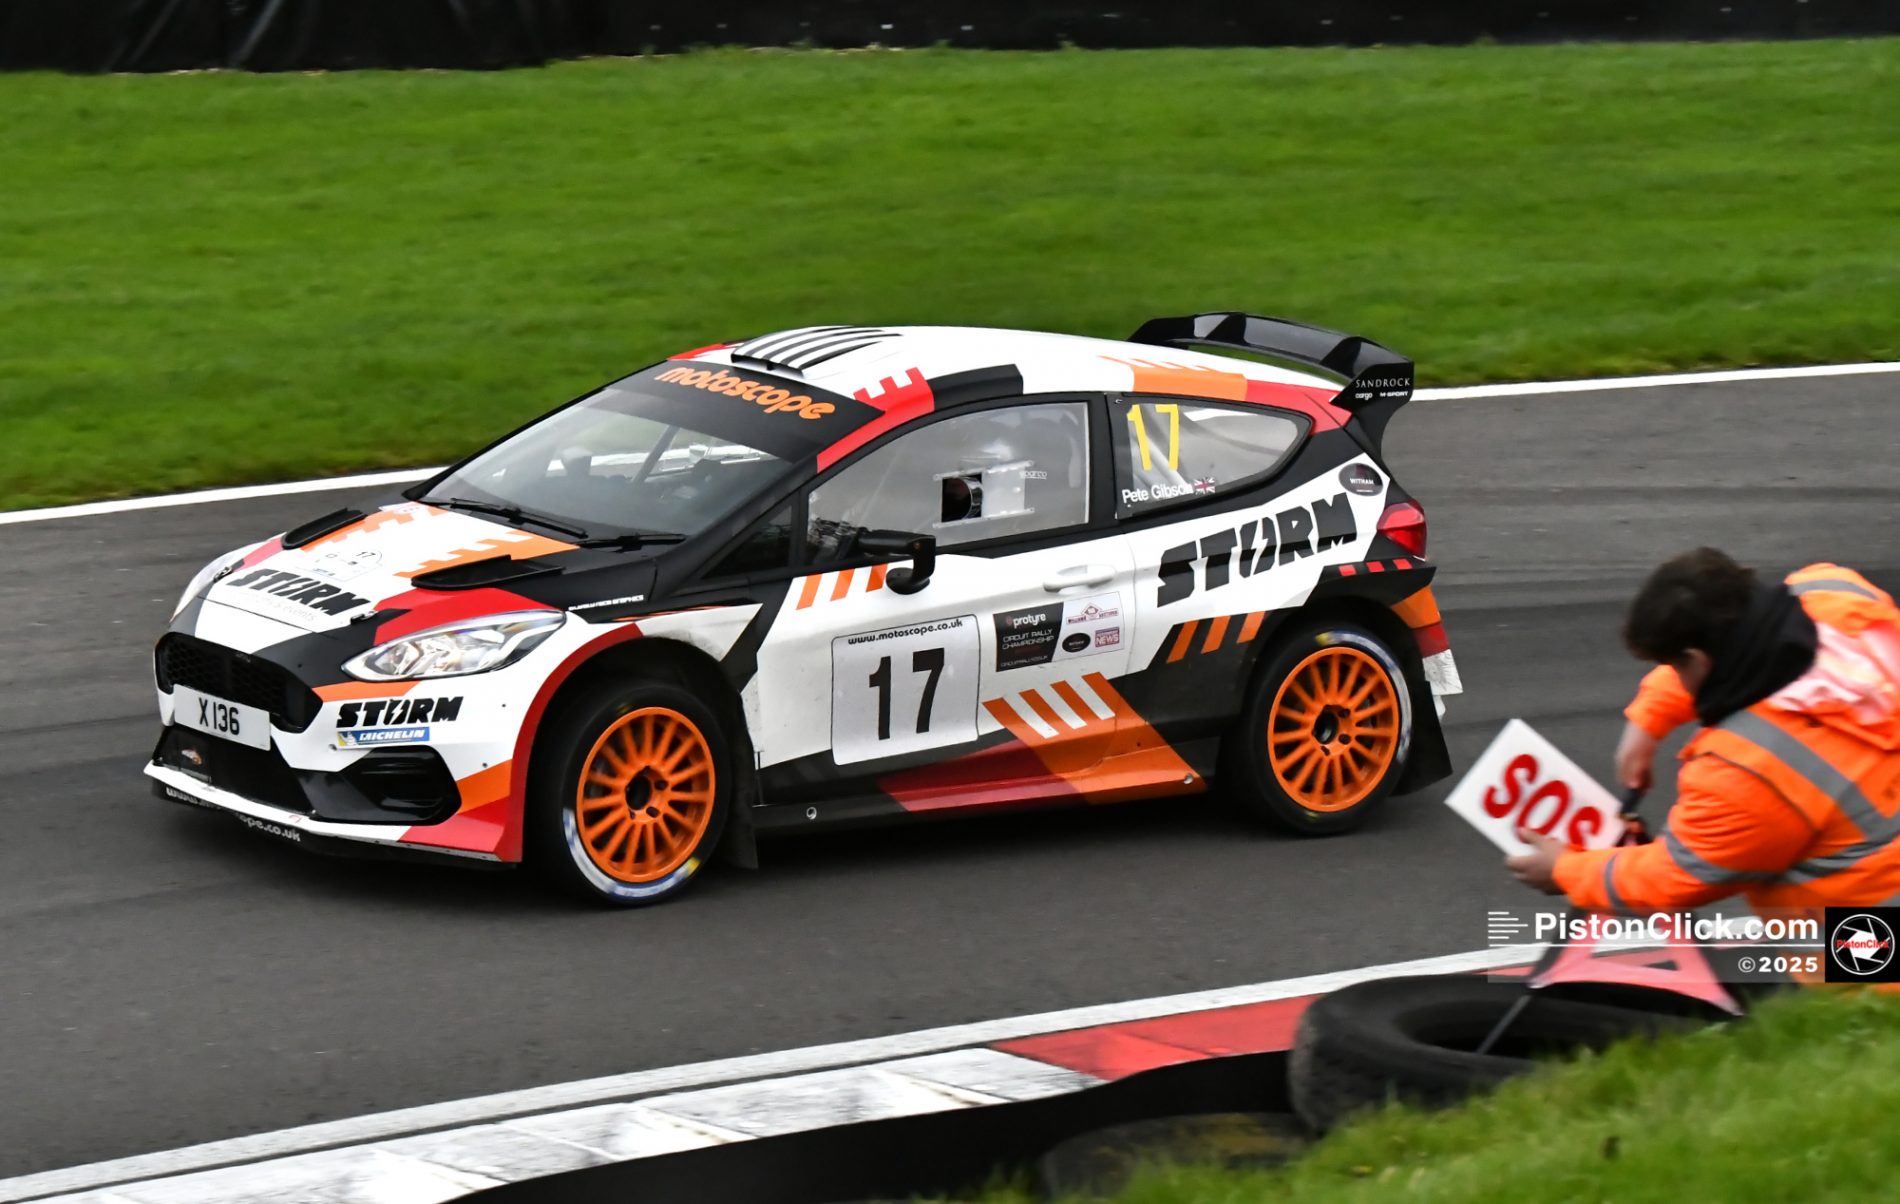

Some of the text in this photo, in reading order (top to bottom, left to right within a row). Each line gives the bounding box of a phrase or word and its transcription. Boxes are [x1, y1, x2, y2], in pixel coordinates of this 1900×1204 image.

[1355, 377, 1410, 388] SANDROCK
[654, 366, 836, 419] motoscope
[1127, 404, 1179, 471] 17
[1122, 488, 1149, 503] Pete
[1013, 613, 1046, 628] protyre
[848, 619, 963, 645] www.motoscope.co.uk
[1003, 628, 1053, 642] CIRCUIT RALLY
[1096, 633, 1119, 645] NEWS
[869, 647, 945, 741] 17
[199, 697, 240, 735] X 136
[359, 729, 425, 741] MICHELIN
